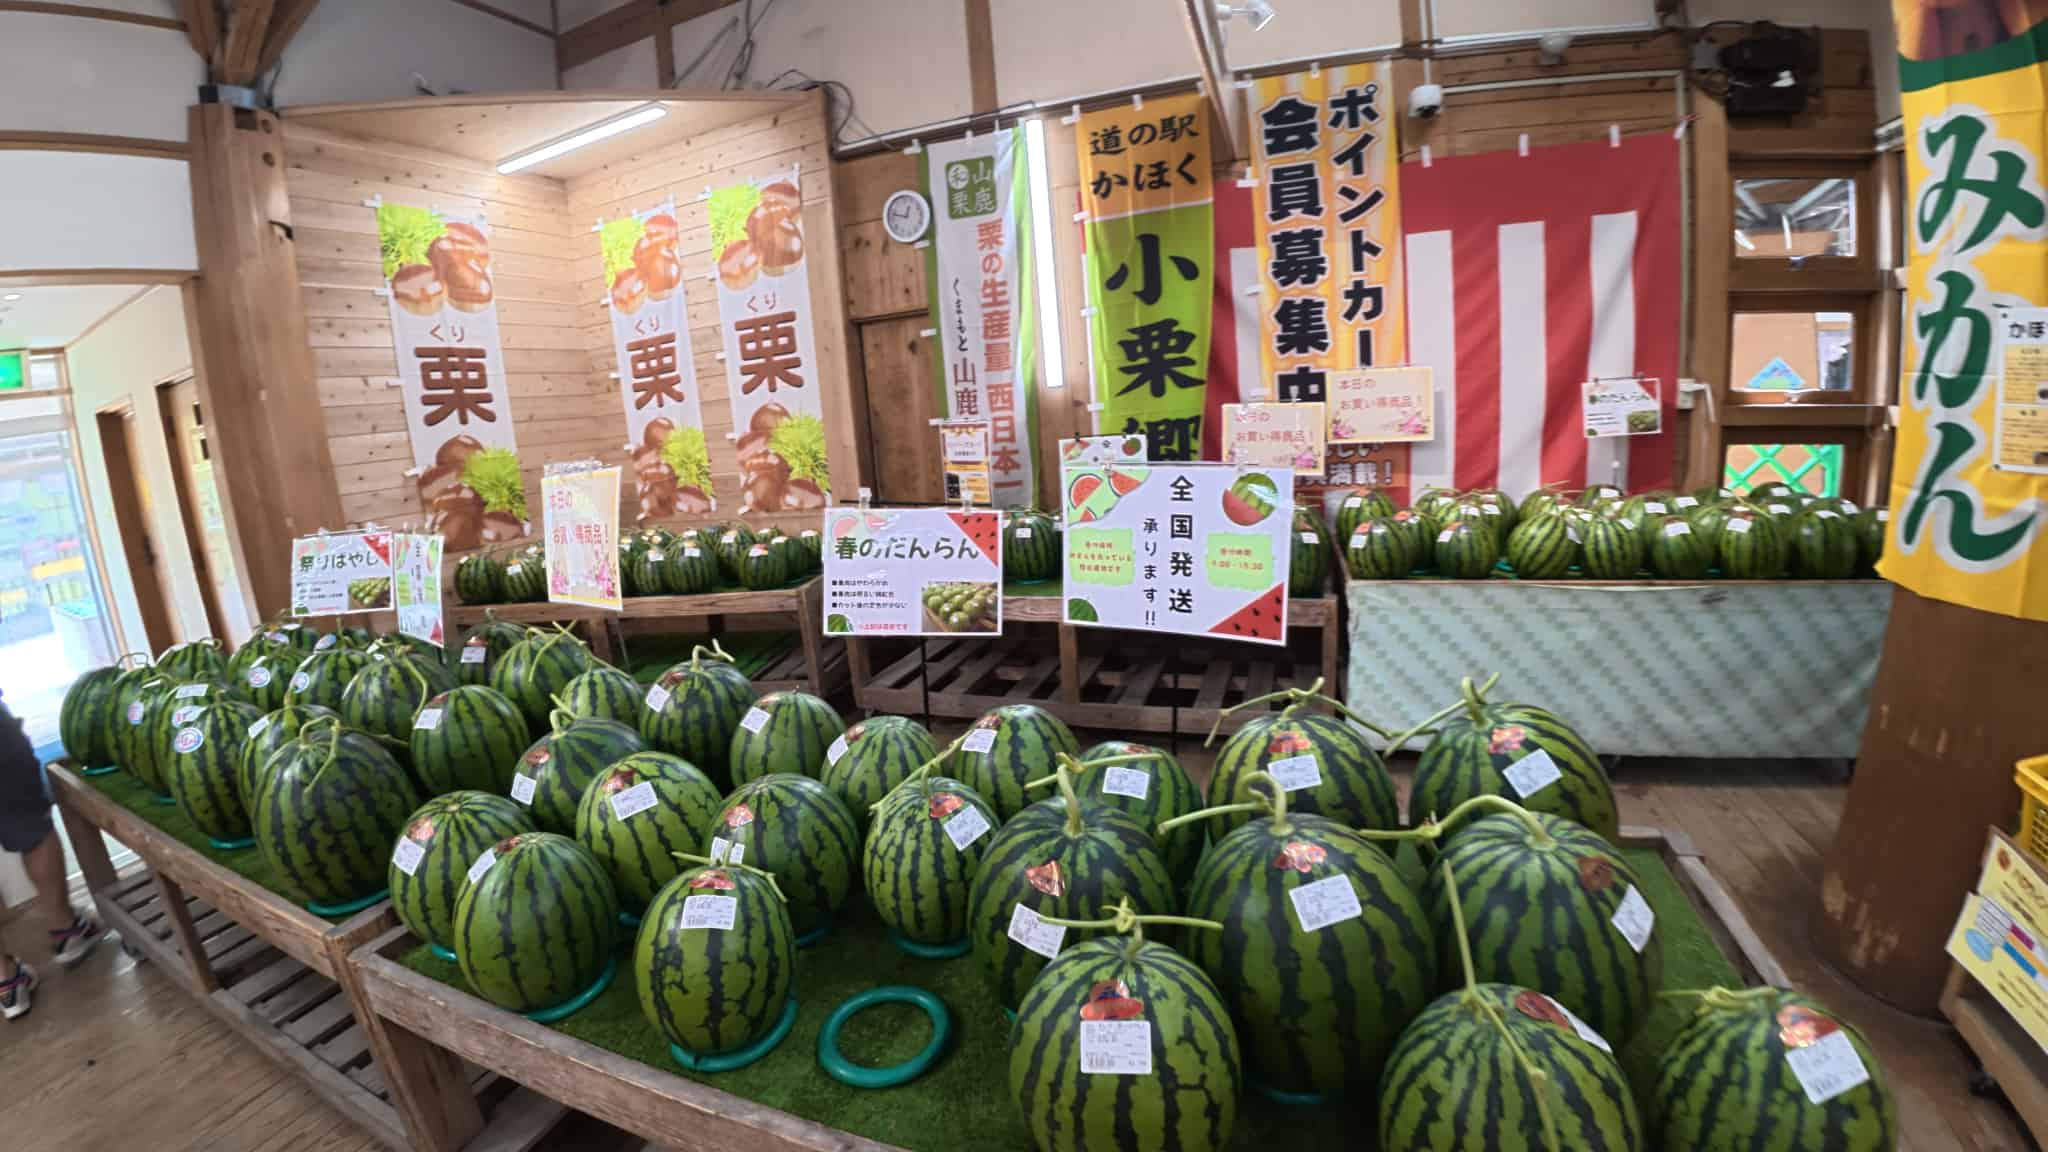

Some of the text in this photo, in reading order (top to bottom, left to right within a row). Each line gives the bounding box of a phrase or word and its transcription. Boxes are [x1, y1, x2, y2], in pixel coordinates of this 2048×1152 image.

[1089, 113, 1200, 156] 道の駅
[971, 160, 994, 213] 山鹿
[1091, 152, 1198, 199] かほく
[1262, 98, 1329, 402] 会員募集中
[1328, 84, 1383, 367] ポイントカー
[633, 316, 660, 335] くり
[746, 292, 776, 311] くり
[430, 326, 465, 343] くり
[734, 311, 804, 395] 栗
[953, 278, 978, 419] くまもと山鹿
[1904, 114, 2045, 562] みかん
[414, 346, 497, 426] 栗
[626, 333, 685, 409] 栗
[300, 551, 379, 572] 祭りはやし
[834, 536, 979, 560] 春のだんらん
[1168, 474, 1194, 614] 全国発送
